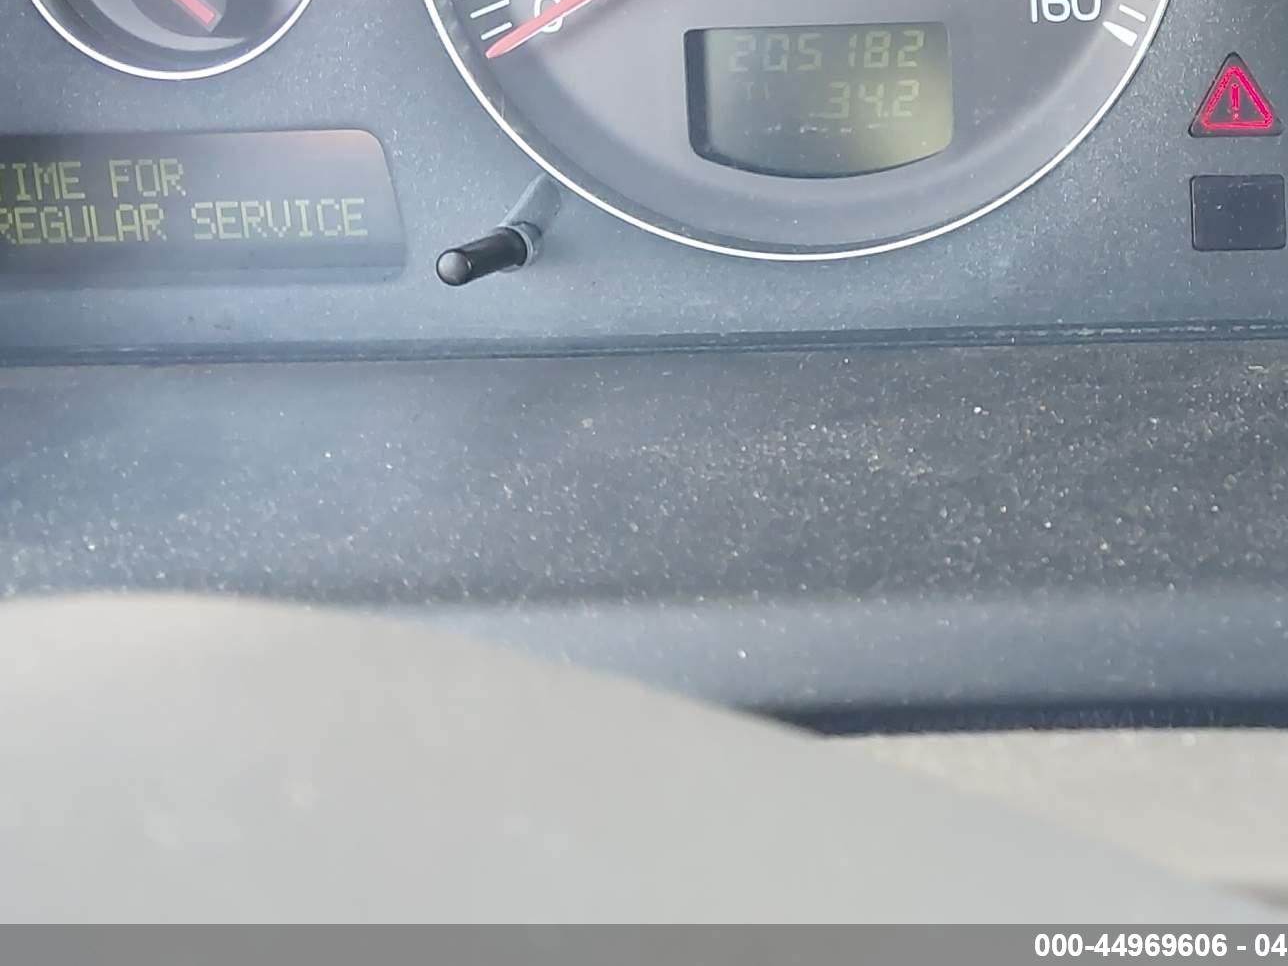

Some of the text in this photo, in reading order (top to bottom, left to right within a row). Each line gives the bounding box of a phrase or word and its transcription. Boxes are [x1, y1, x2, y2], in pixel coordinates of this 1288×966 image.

[729, 30, 925, 72] 205182
[0, 158, 186, 201] IME FOR
[191, 198, 368, 240] SERVICE
